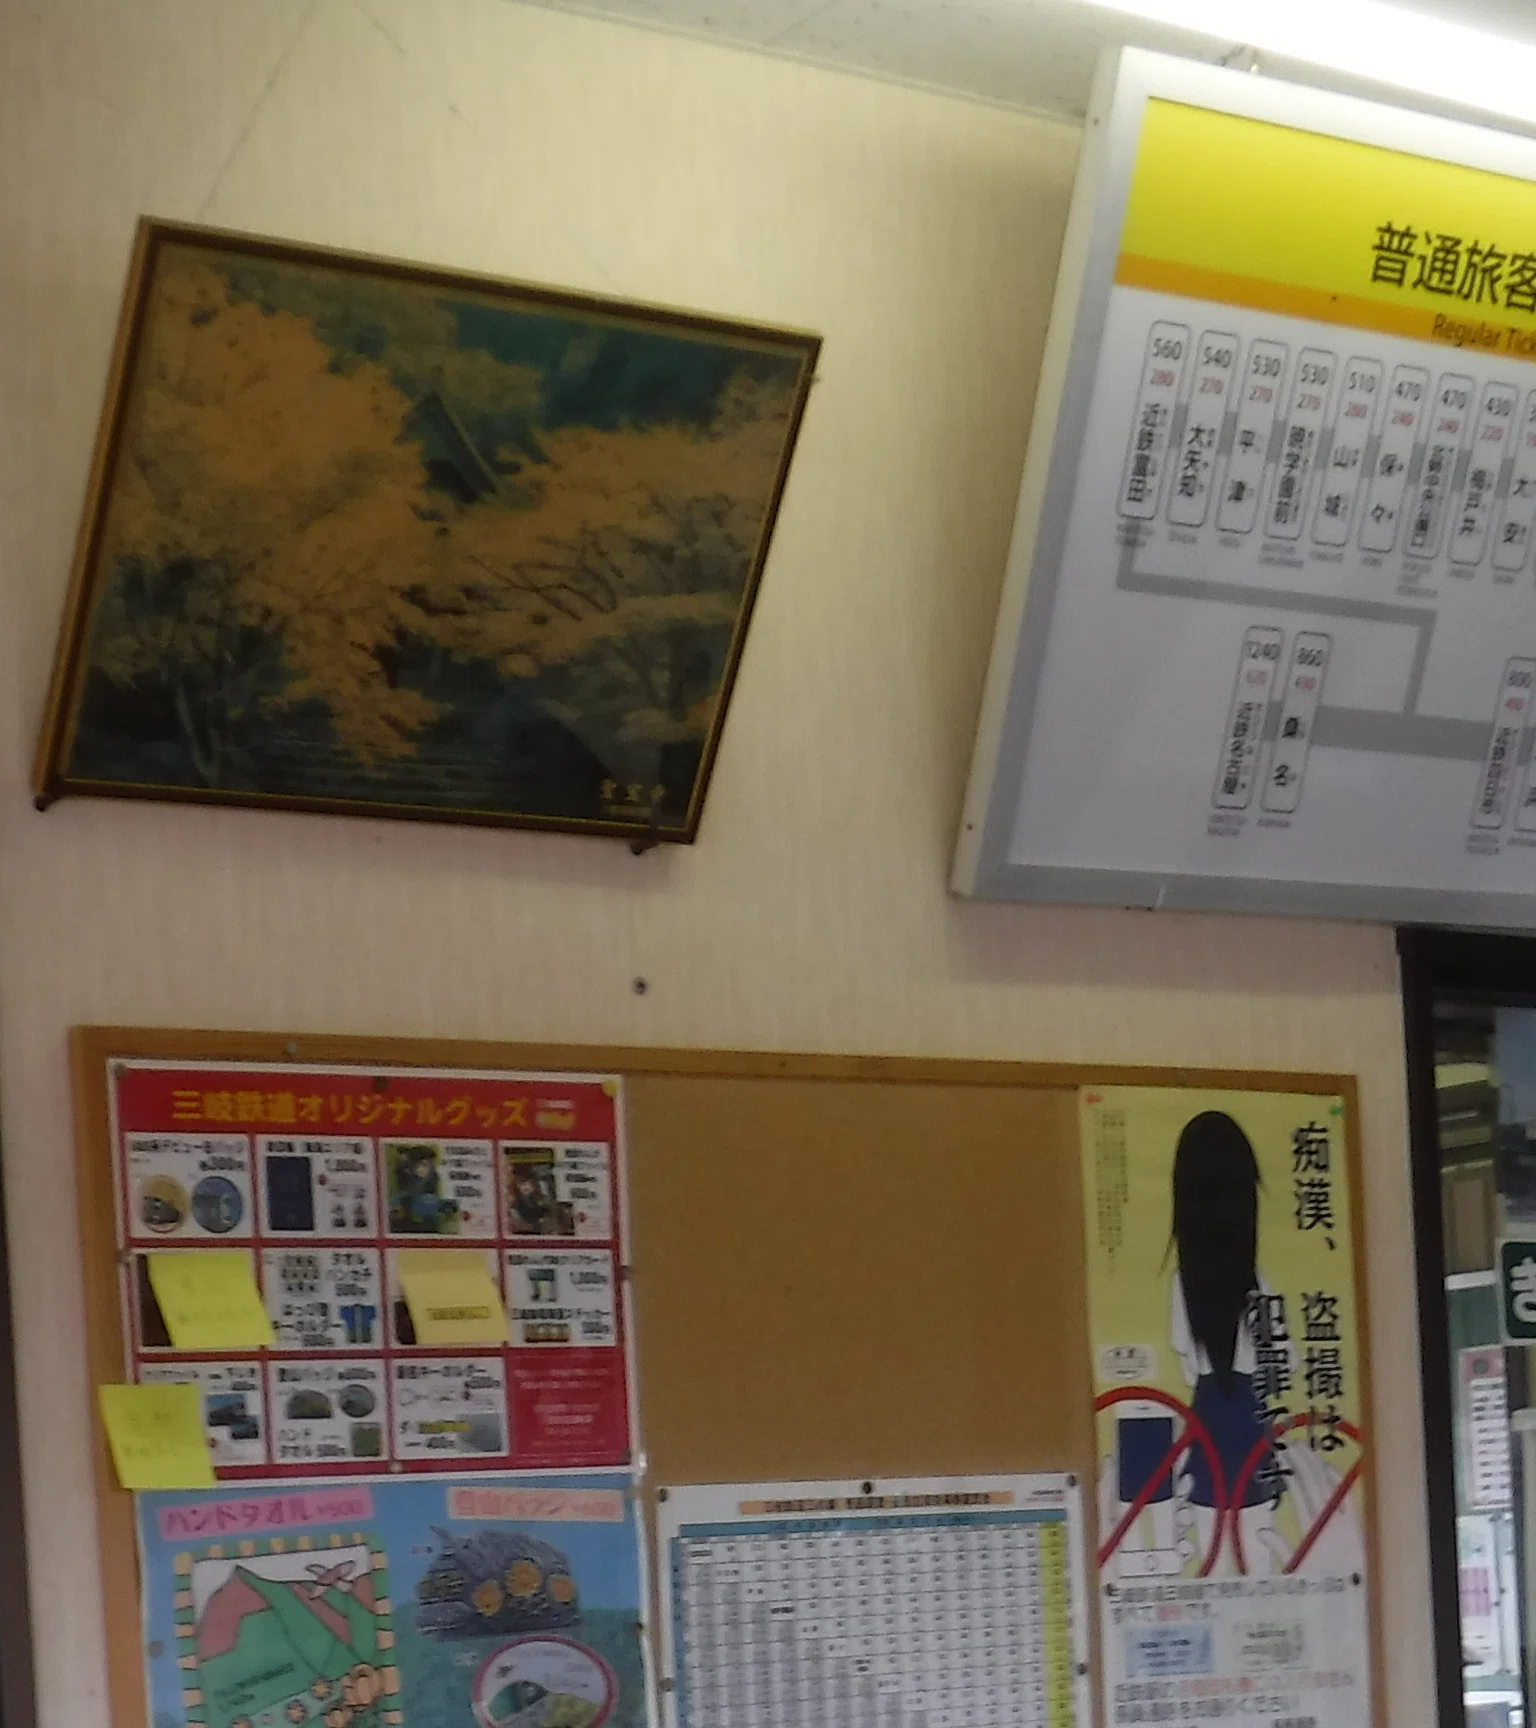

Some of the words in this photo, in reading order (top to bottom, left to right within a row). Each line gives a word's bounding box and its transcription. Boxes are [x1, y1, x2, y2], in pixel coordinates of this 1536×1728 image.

[1431, 312, 1500, 348] Regular
[1153, 337, 1183, 361] 560
[1202, 345, 1233, 369] 540
[1252, 353, 1282, 377] 530
[1300, 362, 1329, 386] 530
[170, 1088, 529, 1127] 三岐鉄道オリジナルグッズ
[1290, 1120, 1336, 1251] 痴漢、
[1300, 1290, 1346, 1453] 盗撮は
[1245, 1292, 1296, 1512] 犯罪です
